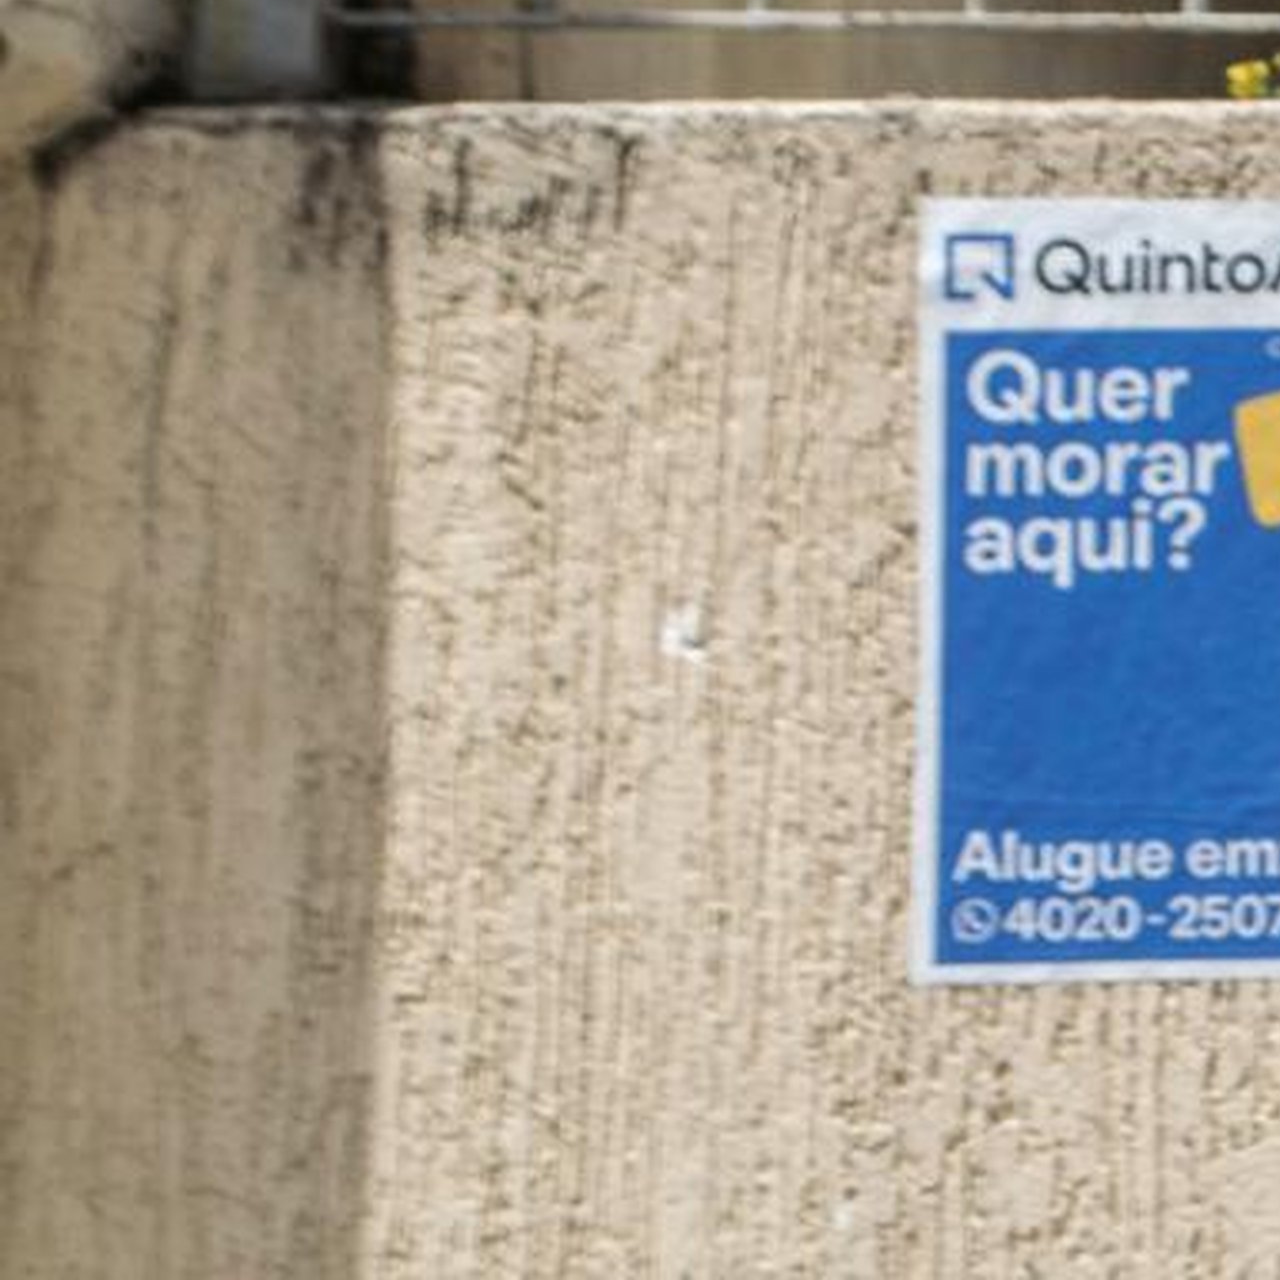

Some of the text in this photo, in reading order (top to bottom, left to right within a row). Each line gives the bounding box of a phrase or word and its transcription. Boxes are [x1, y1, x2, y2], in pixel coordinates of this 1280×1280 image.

[965, 349, 1190, 424] Quer
[964, 435, 1230, 497] morar
[963, 498, 1207, 588] aqui?
[952, 829, 1173, 892] Alugue
